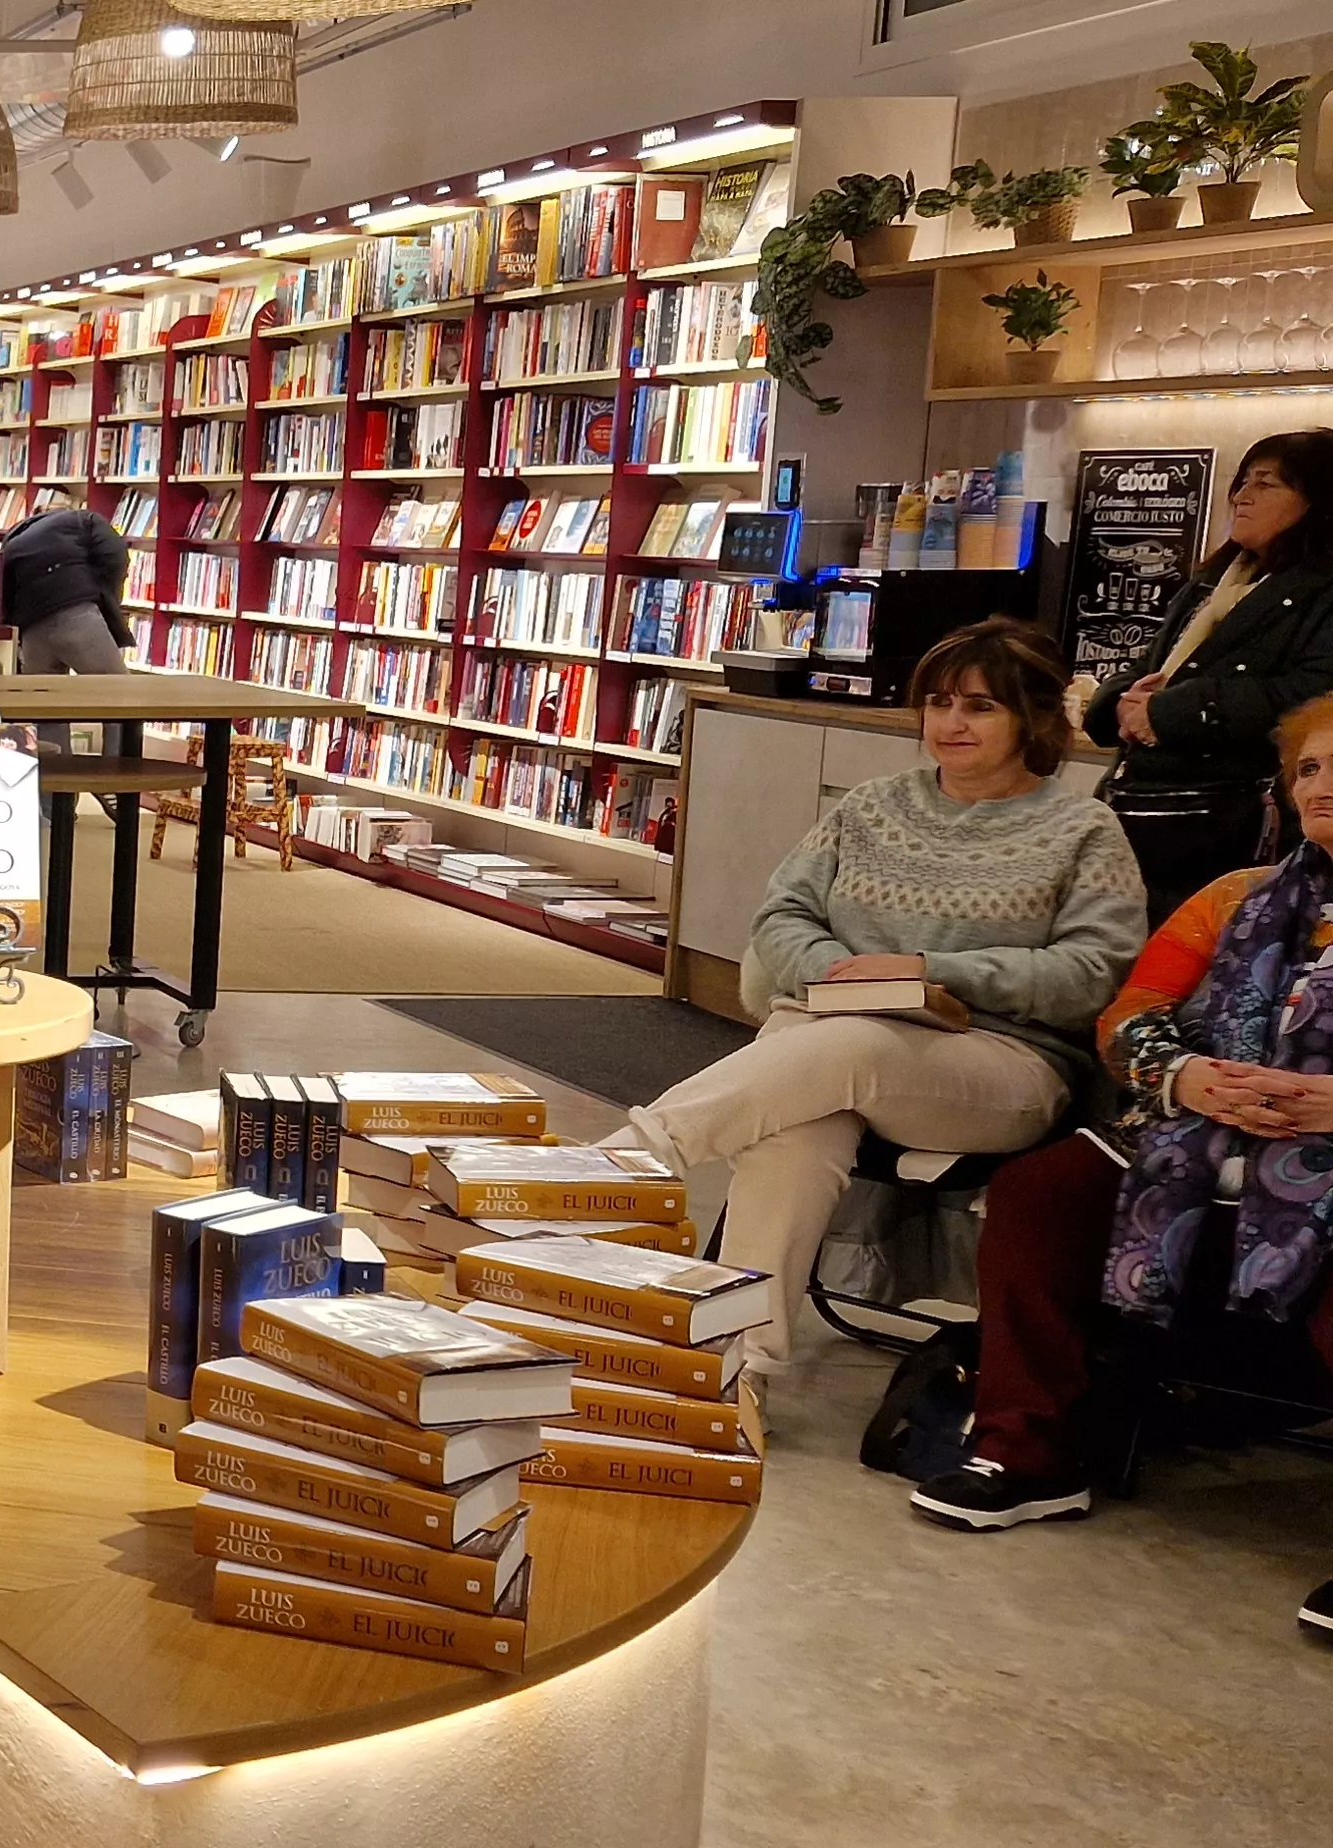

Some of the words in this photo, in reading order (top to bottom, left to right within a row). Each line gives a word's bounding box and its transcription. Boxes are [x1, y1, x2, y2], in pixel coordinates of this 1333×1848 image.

[715, 169, 759, 188] HISTORIA
[1117, 468, 1170, 492] eboca
[1093, 510, 1149, 523] COMERCIO
[1150, 510, 1185, 523] JUSTO
[22, 1067, 57, 1092] ZUECO
[69, 1067, 79, 1100] ZUECO
[77, 1073, 85, 1093] LUIS
[363, 1118, 410, 1129] ZUECO
[372, 1106, 402, 1118] LUIS
[438, 1112, 455, 1125] EL
[70, 1119, 79, 1160] CASTILLO
[113, 1109, 122, 1161] MONASTERIO
[238, 1111, 253, 1158] ZUECO
[253, 1121, 266, 1149] LUIS
[273, 1113, 288, 1160] ZUECO
[287, 1124, 301, 1153] LUIS
[311, 1115, 326, 1162] ZUECO
[325, 1125, 339, 1154] LUIS
[485, 1186, 520, 1200] LUIS
[562, 1194, 582, 1209] EL
[474, 1199, 529, 1213] ZUECO
[279, 1232, 322, 1264] LUIS
[163, 1252, 174, 1276] LUIS
[263, 1256, 331, 1293] ZUECO
[213, 1267, 224, 1292] LUIS
[482, 1266, 516, 1287] LUIS
[161, 1277, 173, 1312] ZUECO
[471, 1279, 524, 1303] ZUECO
[558, 1289, 580, 1309] EL
[211, 1293, 223, 1328] ZUECO
[259, 1321, 286, 1343] LUIS
[159, 1335, 171, 1386] CASTILLO
[251, 1335, 293, 1364] ZUECO
[573, 1349, 595, 1368] EL
[221, 1384, 256, 1408] LUIS
[209, 1397, 265, 1429] ZUECO
[586, 1403, 608, 1422] EL
[206, 1449, 246, 1473] LUIS
[608, 1461, 632, 1480] EL
[194, 1465, 257, 1493] ZUECO
[297, 1479, 320, 1502] EL
[228, 1520, 272, 1545] LUIS
[215, 1535, 283, 1564] ZUECO
[327, 1549, 354, 1573] EL
[250, 1587, 294, 1610] LUIS
[235, 1603, 306, 1630] ZUECO
[353, 1613, 378, 1636] EL
